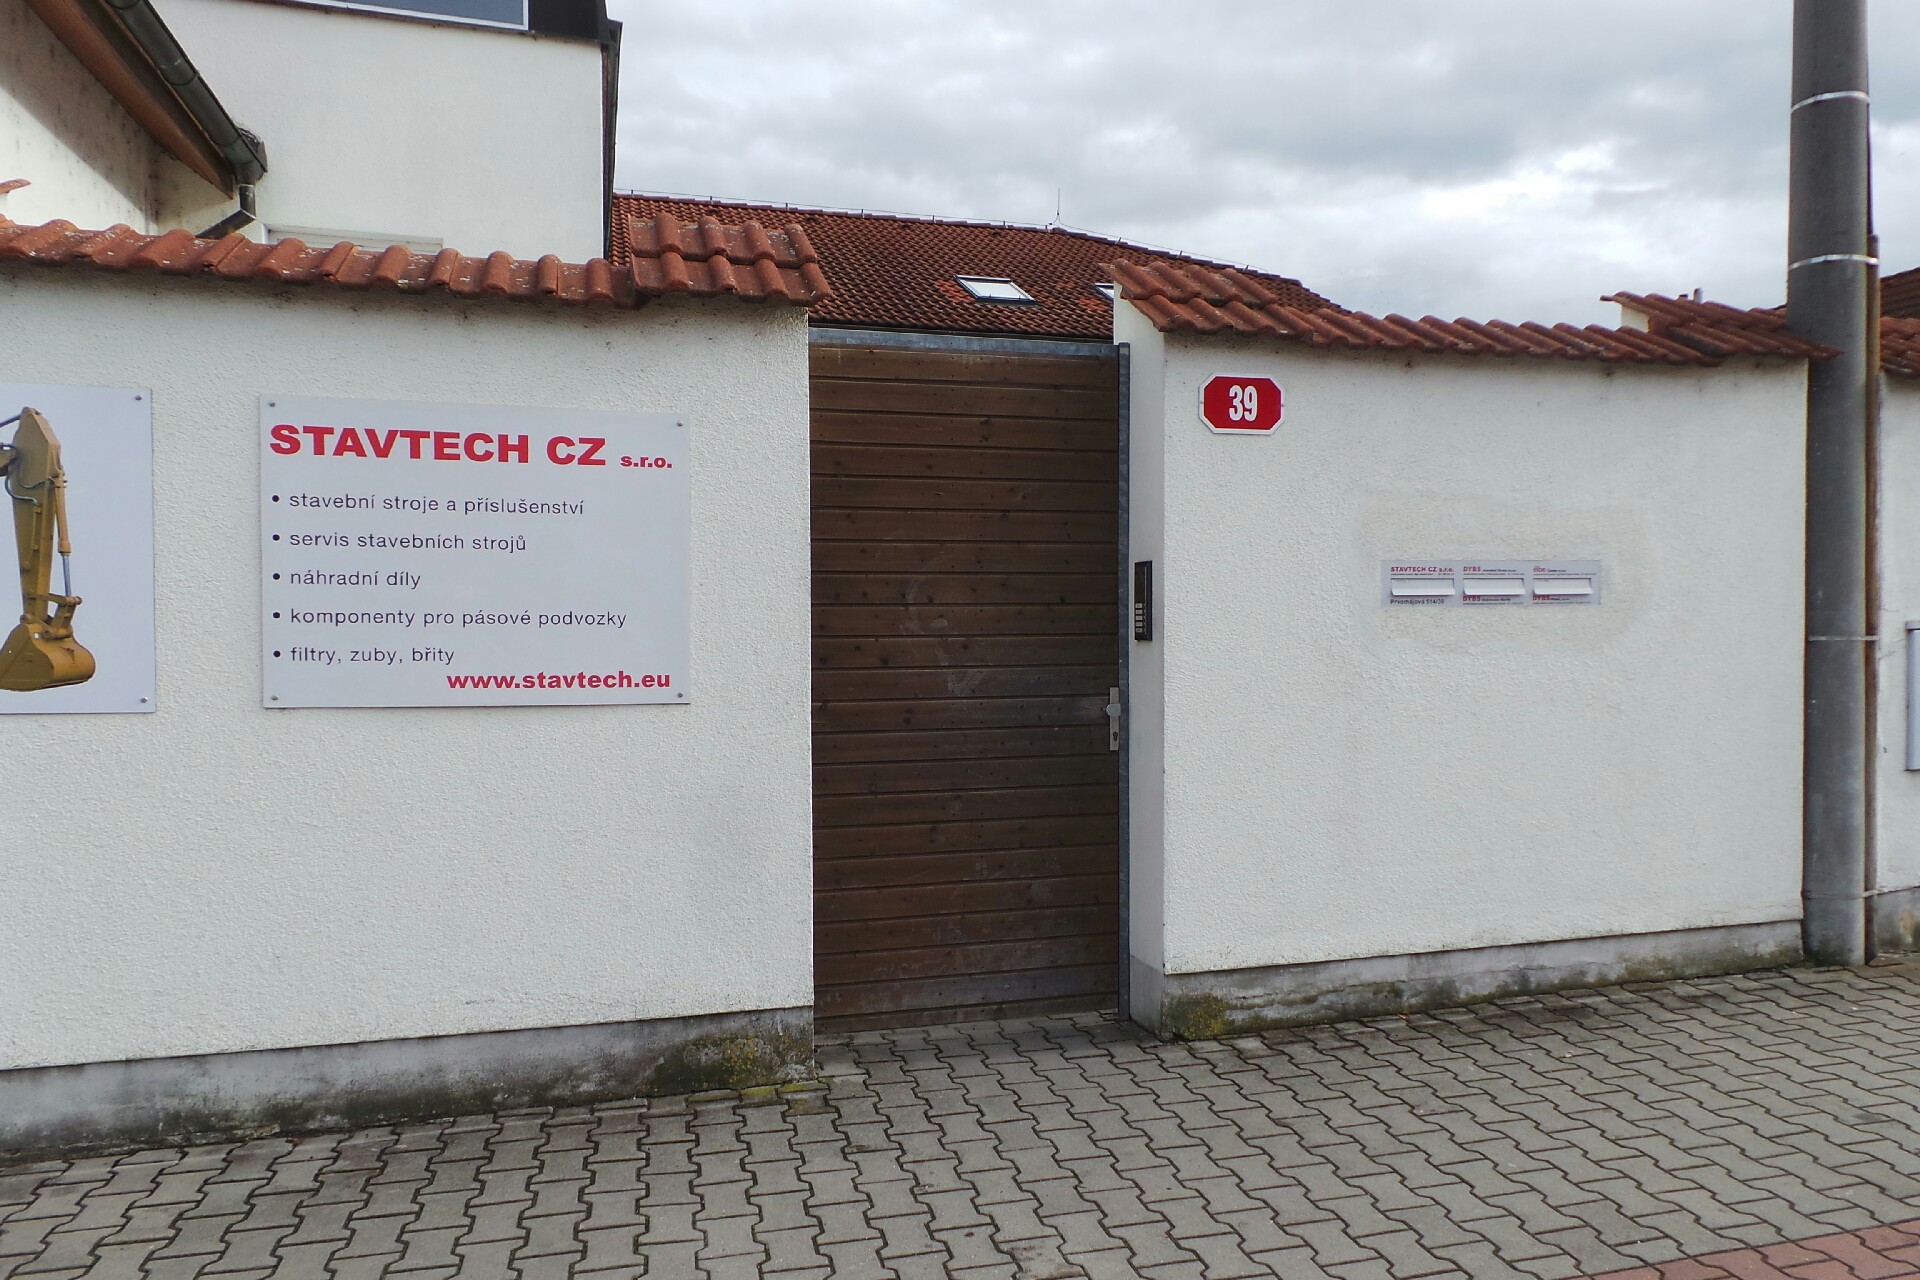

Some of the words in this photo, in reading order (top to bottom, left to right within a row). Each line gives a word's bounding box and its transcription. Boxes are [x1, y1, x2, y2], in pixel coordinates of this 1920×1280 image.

[1229, 385, 1257, 421] 39
[270, 424, 528, 463] STAVTECH
[547, 436, 606, 465] CZ
[620, 456, 672, 468] s.r.o.
[290, 493, 375, 508] stavební
[383, 496, 438, 514] stroje
[447, 500, 456, 511] a
[465, 498, 584, 515] příslušenství
[290, 532, 349, 546] servis
[358, 534, 463, 549] stavebních
[473, 535, 525, 553] strojů
[291, 570, 378, 585] náhradní
[387, 572, 420, 590] díly
[291, 608, 415, 627] komponenty
[424, 613, 454, 627] pro
[463, 610, 530, 628] pásové
[539, 611, 626, 628] podvozky
[290, 647, 341, 665] filtry,
[350, 648, 402, 665] zuby,
[412, 647, 454, 665] břity
[447, 671, 669, 688] www.stavtech.eu
